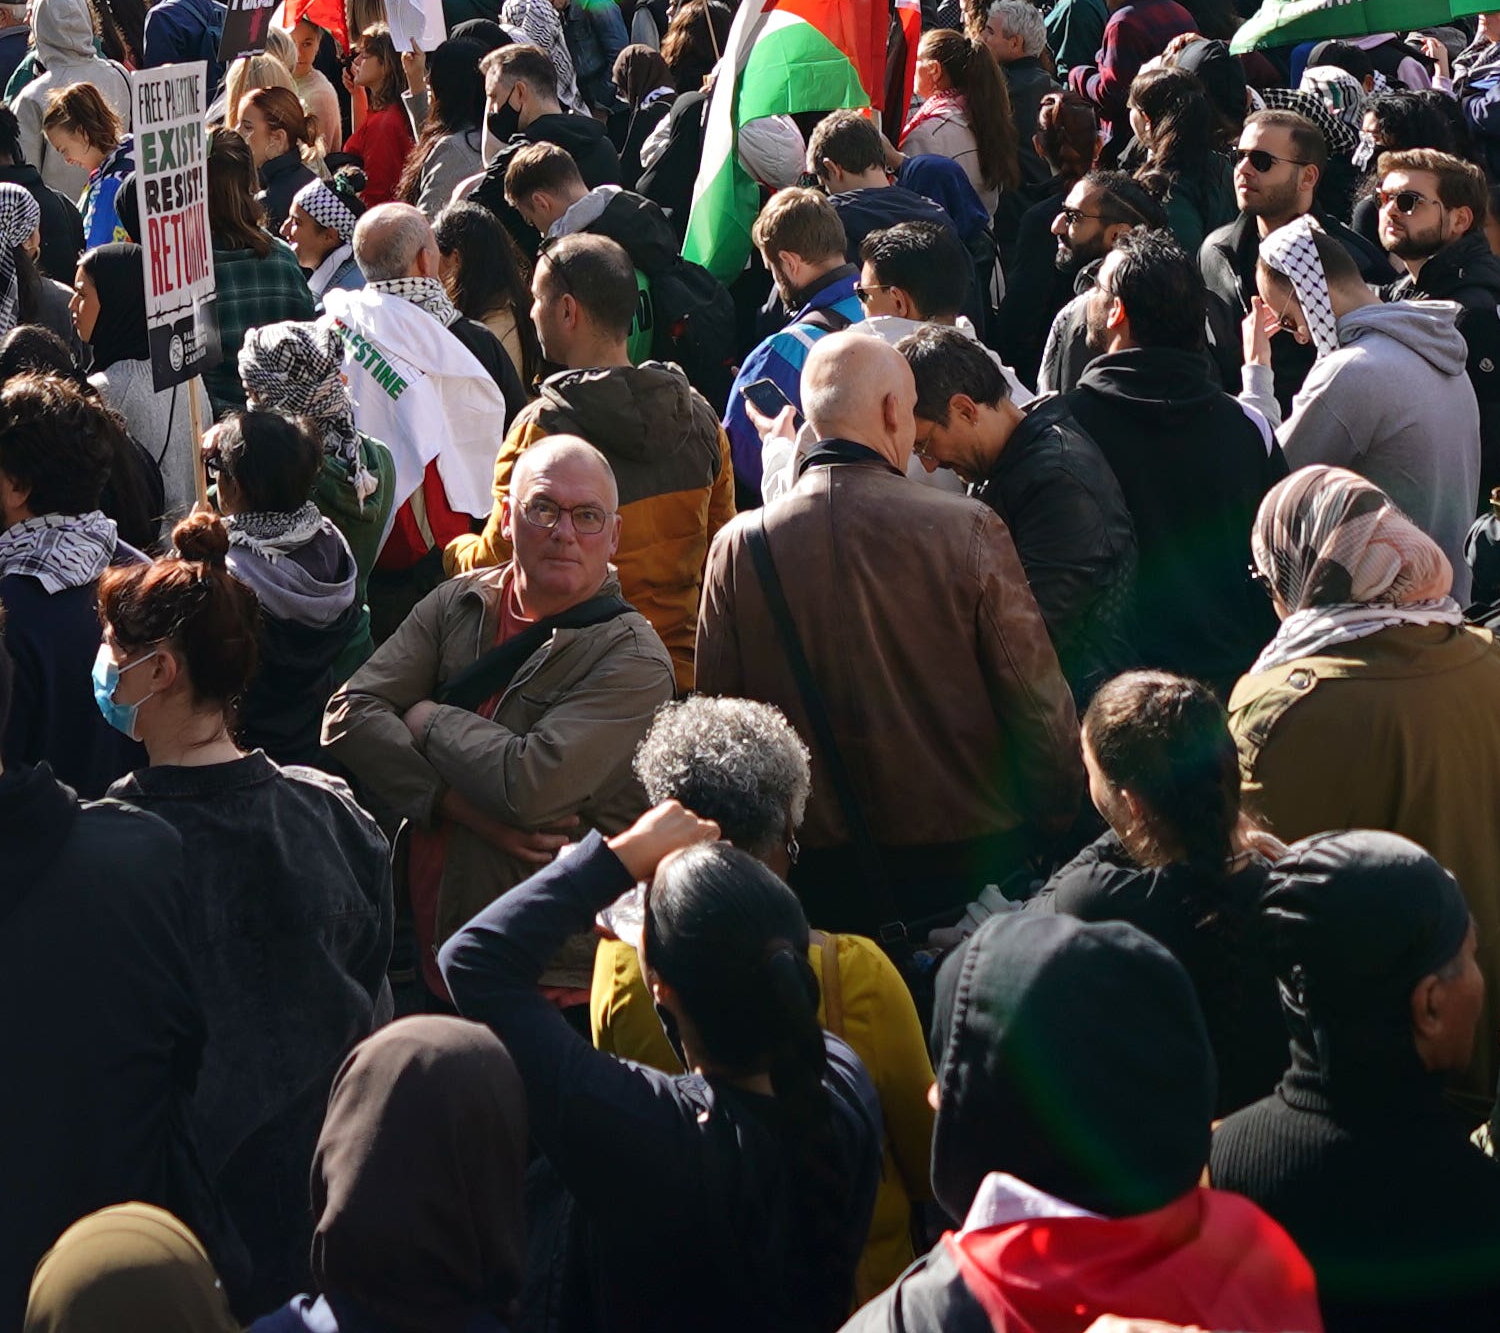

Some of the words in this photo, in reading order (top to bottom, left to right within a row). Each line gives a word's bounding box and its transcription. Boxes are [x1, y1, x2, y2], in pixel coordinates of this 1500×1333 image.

[138, 81, 164, 125] FREE
[165, 74, 201, 120] PALESTINE
[140, 121, 202, 176] EXIST!
[144, 166, 204, 216] RESIST!
[147, 202, 210, 298] RETURN!
